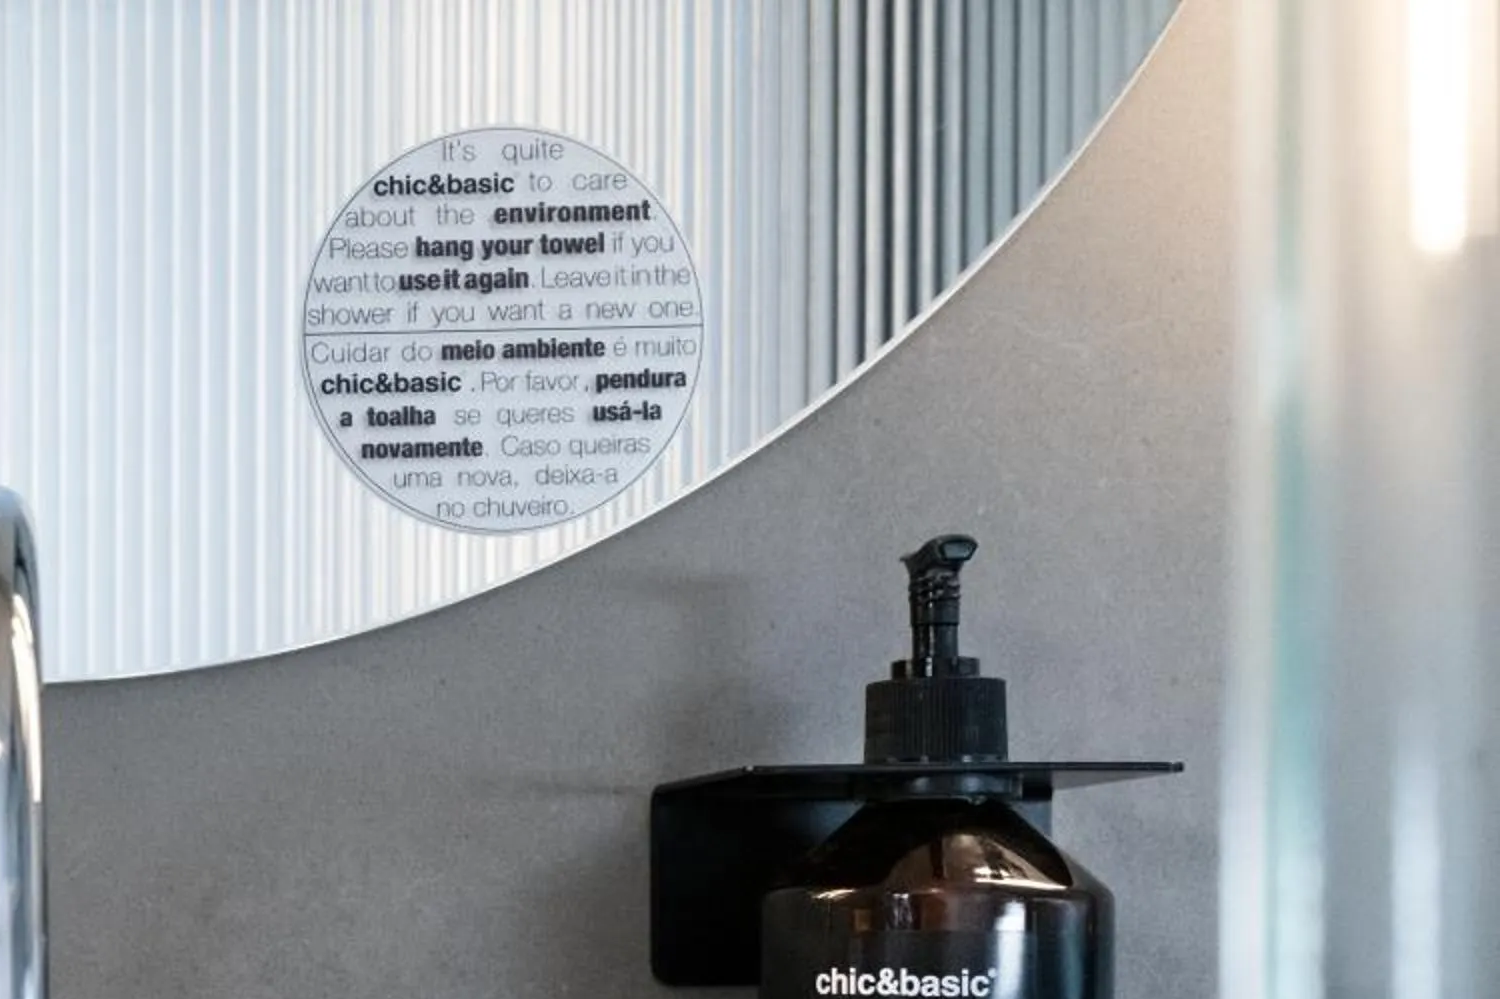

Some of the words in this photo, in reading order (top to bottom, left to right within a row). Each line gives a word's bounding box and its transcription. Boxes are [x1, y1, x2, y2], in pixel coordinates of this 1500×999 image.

[442, 139, 477, 162] It's
[501, 137, 564, 165] quite
[373, 171, 516, 196] chic&basic
[528, 171, 553, 193] to
[571, 172, 629, 191] care
[344, 205, 415, 228] about
[436, 202, 476, 226] the
[328, 236, 409, 260] Please
[415, 235, 474, 261] hang
[481, 237, 534, 262] your
[540, 231, 605, 255] towel
[611, 231, 624, 253] if
[631, 234, 675, 258] you
[313, 271, 369, 293] want
[373, 271, 396, 293] to
[399, 272, 441, 291] use
[443, 268, 461, 290] it
[541, 265, 611, 289] Leave
[614, 264, 627, 287] it
[630, 263, 650, 287] in
[654, 263, 691, 287] the
[307, 302, 394, 326] shower
[407, 300, 419, 324] if
[430, 303, 476, 329] you
[487, 299, 546, 322] want
[557, 303, 573, 320] a
[585, 301, 637, 321] new
[310, 340, 391, 364] Cuidar
[401, 341, 434, 363] do
[440, 339, 496, 362] meio
[501, 337, 606, 359] ambiente
[613, 335, 627, 357] é
[635, 335, 697, 357] muito
[481, 370, 516, 393] Por
[595, 367, 687, 394] pendura
[339, 410, 353, 428] a
[366, 404, 437, 427] toalha
[453, 407, 482, 426] se
[496, 404, 576, 428] queres
[592, 399, 663, 422] usá-la
[500, 434, 562, 457] Caso
[568, 433, 652, 458] queiras
[393, 468, 443, 490] uma
[456, 466, 519, 489] nova,
[534, 462, 619, 486] deixa-a
[435, 500, 465, 520] no
[472, 495, 577, 519] chuveiro.
